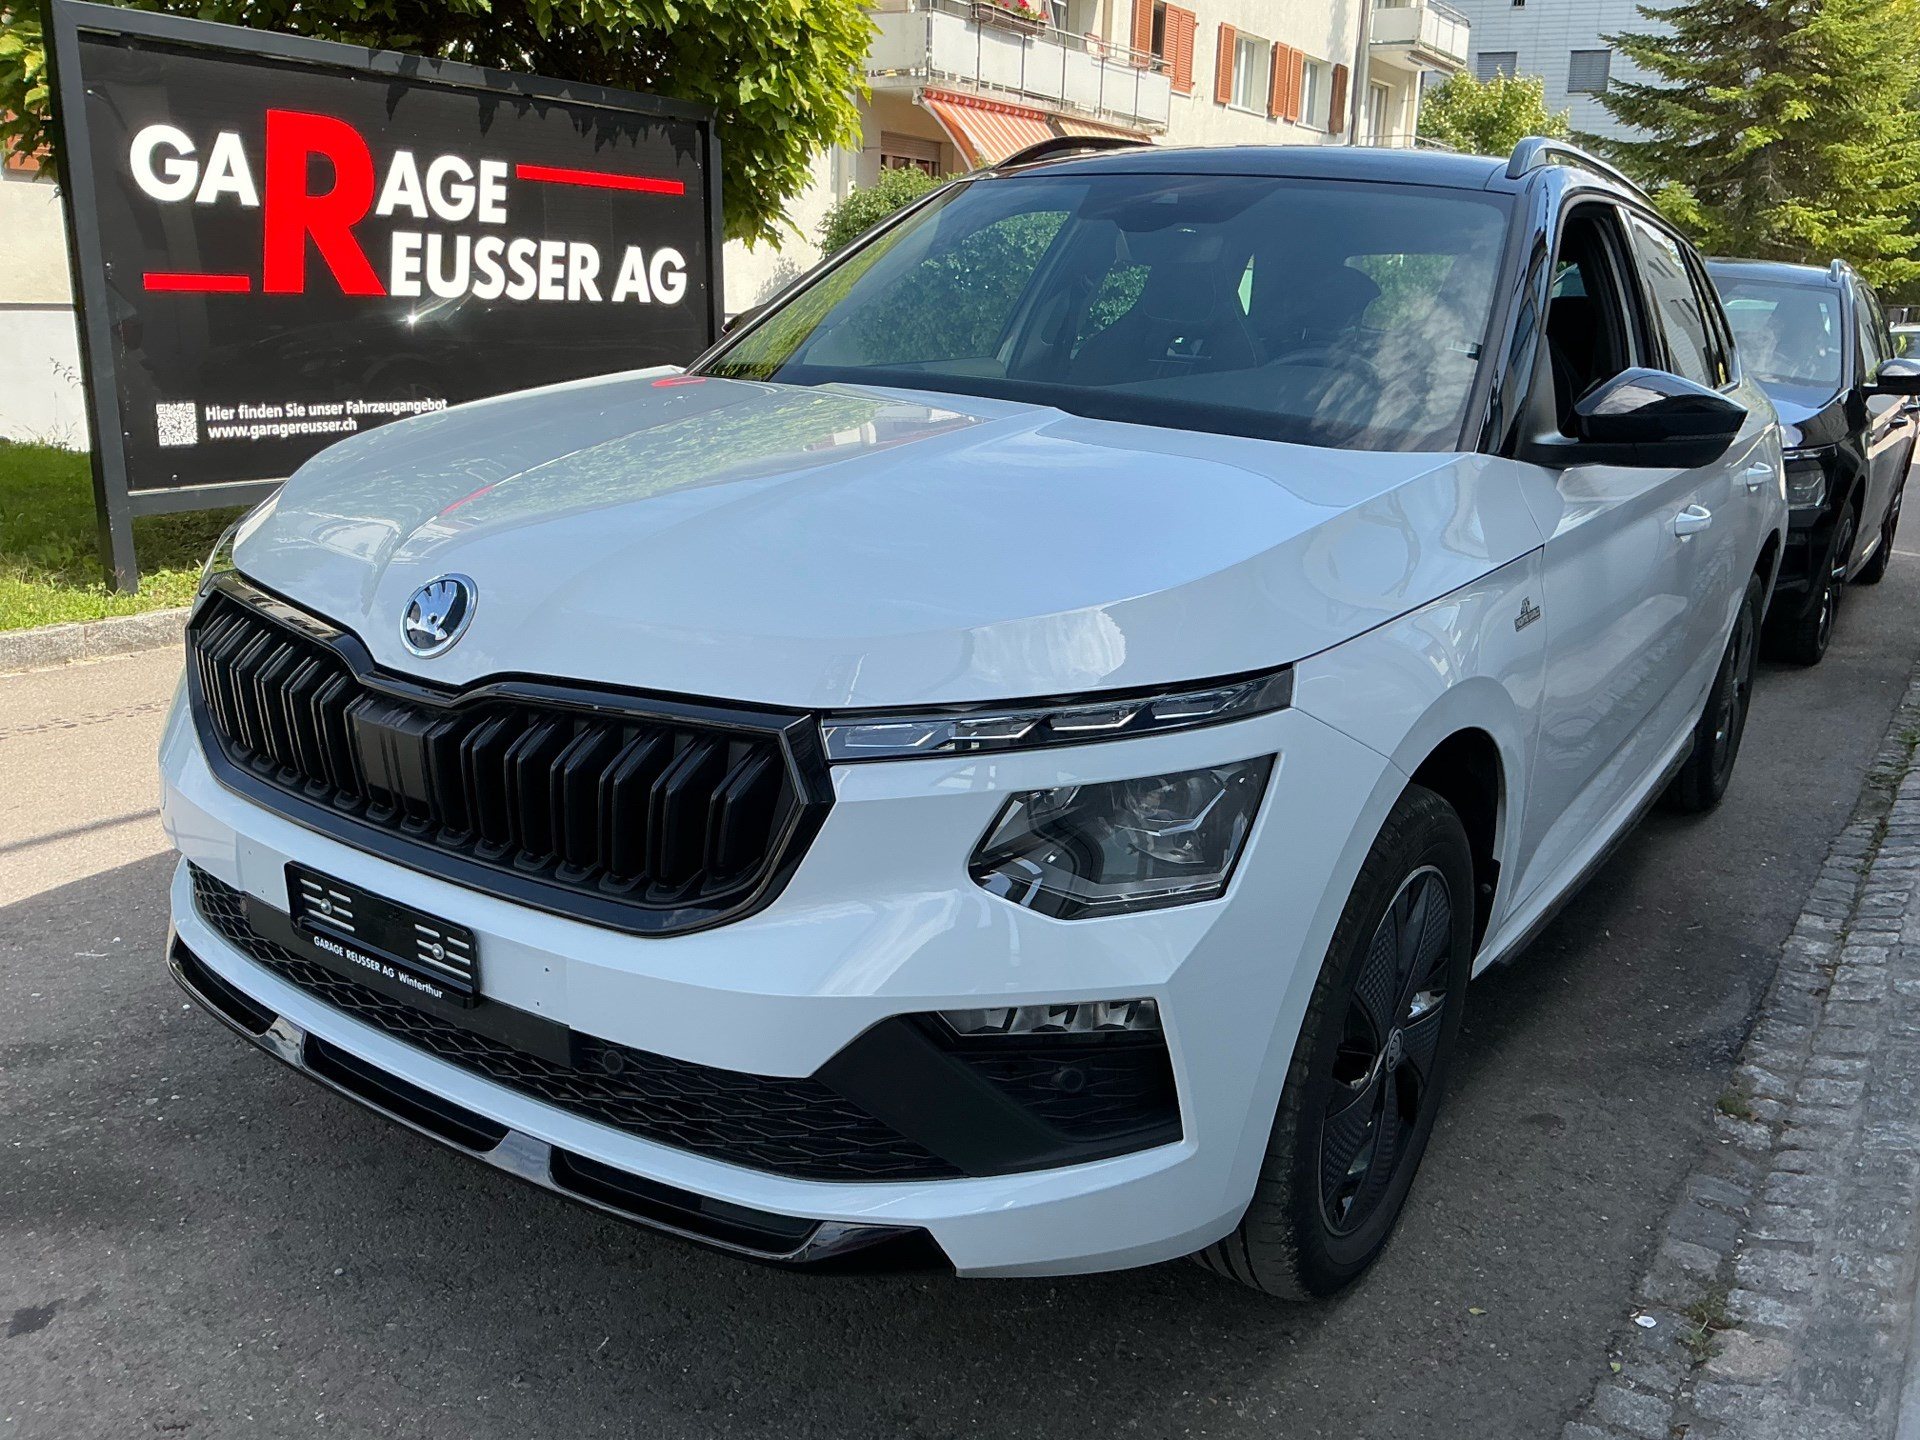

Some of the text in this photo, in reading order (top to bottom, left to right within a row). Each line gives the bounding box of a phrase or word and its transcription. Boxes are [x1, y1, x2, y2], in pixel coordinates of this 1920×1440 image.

[129, 109, 508, 295] GARAGE
[612, 246, 688, 304] AG
[205, 399, 447, 421] Hier finden Sie unser Fahrzeugangebot
[208, 418, 357, 438] www.garagereusser.ch
[313, 936, 442, 998] GARAGE REUSSER AG Winterthur
